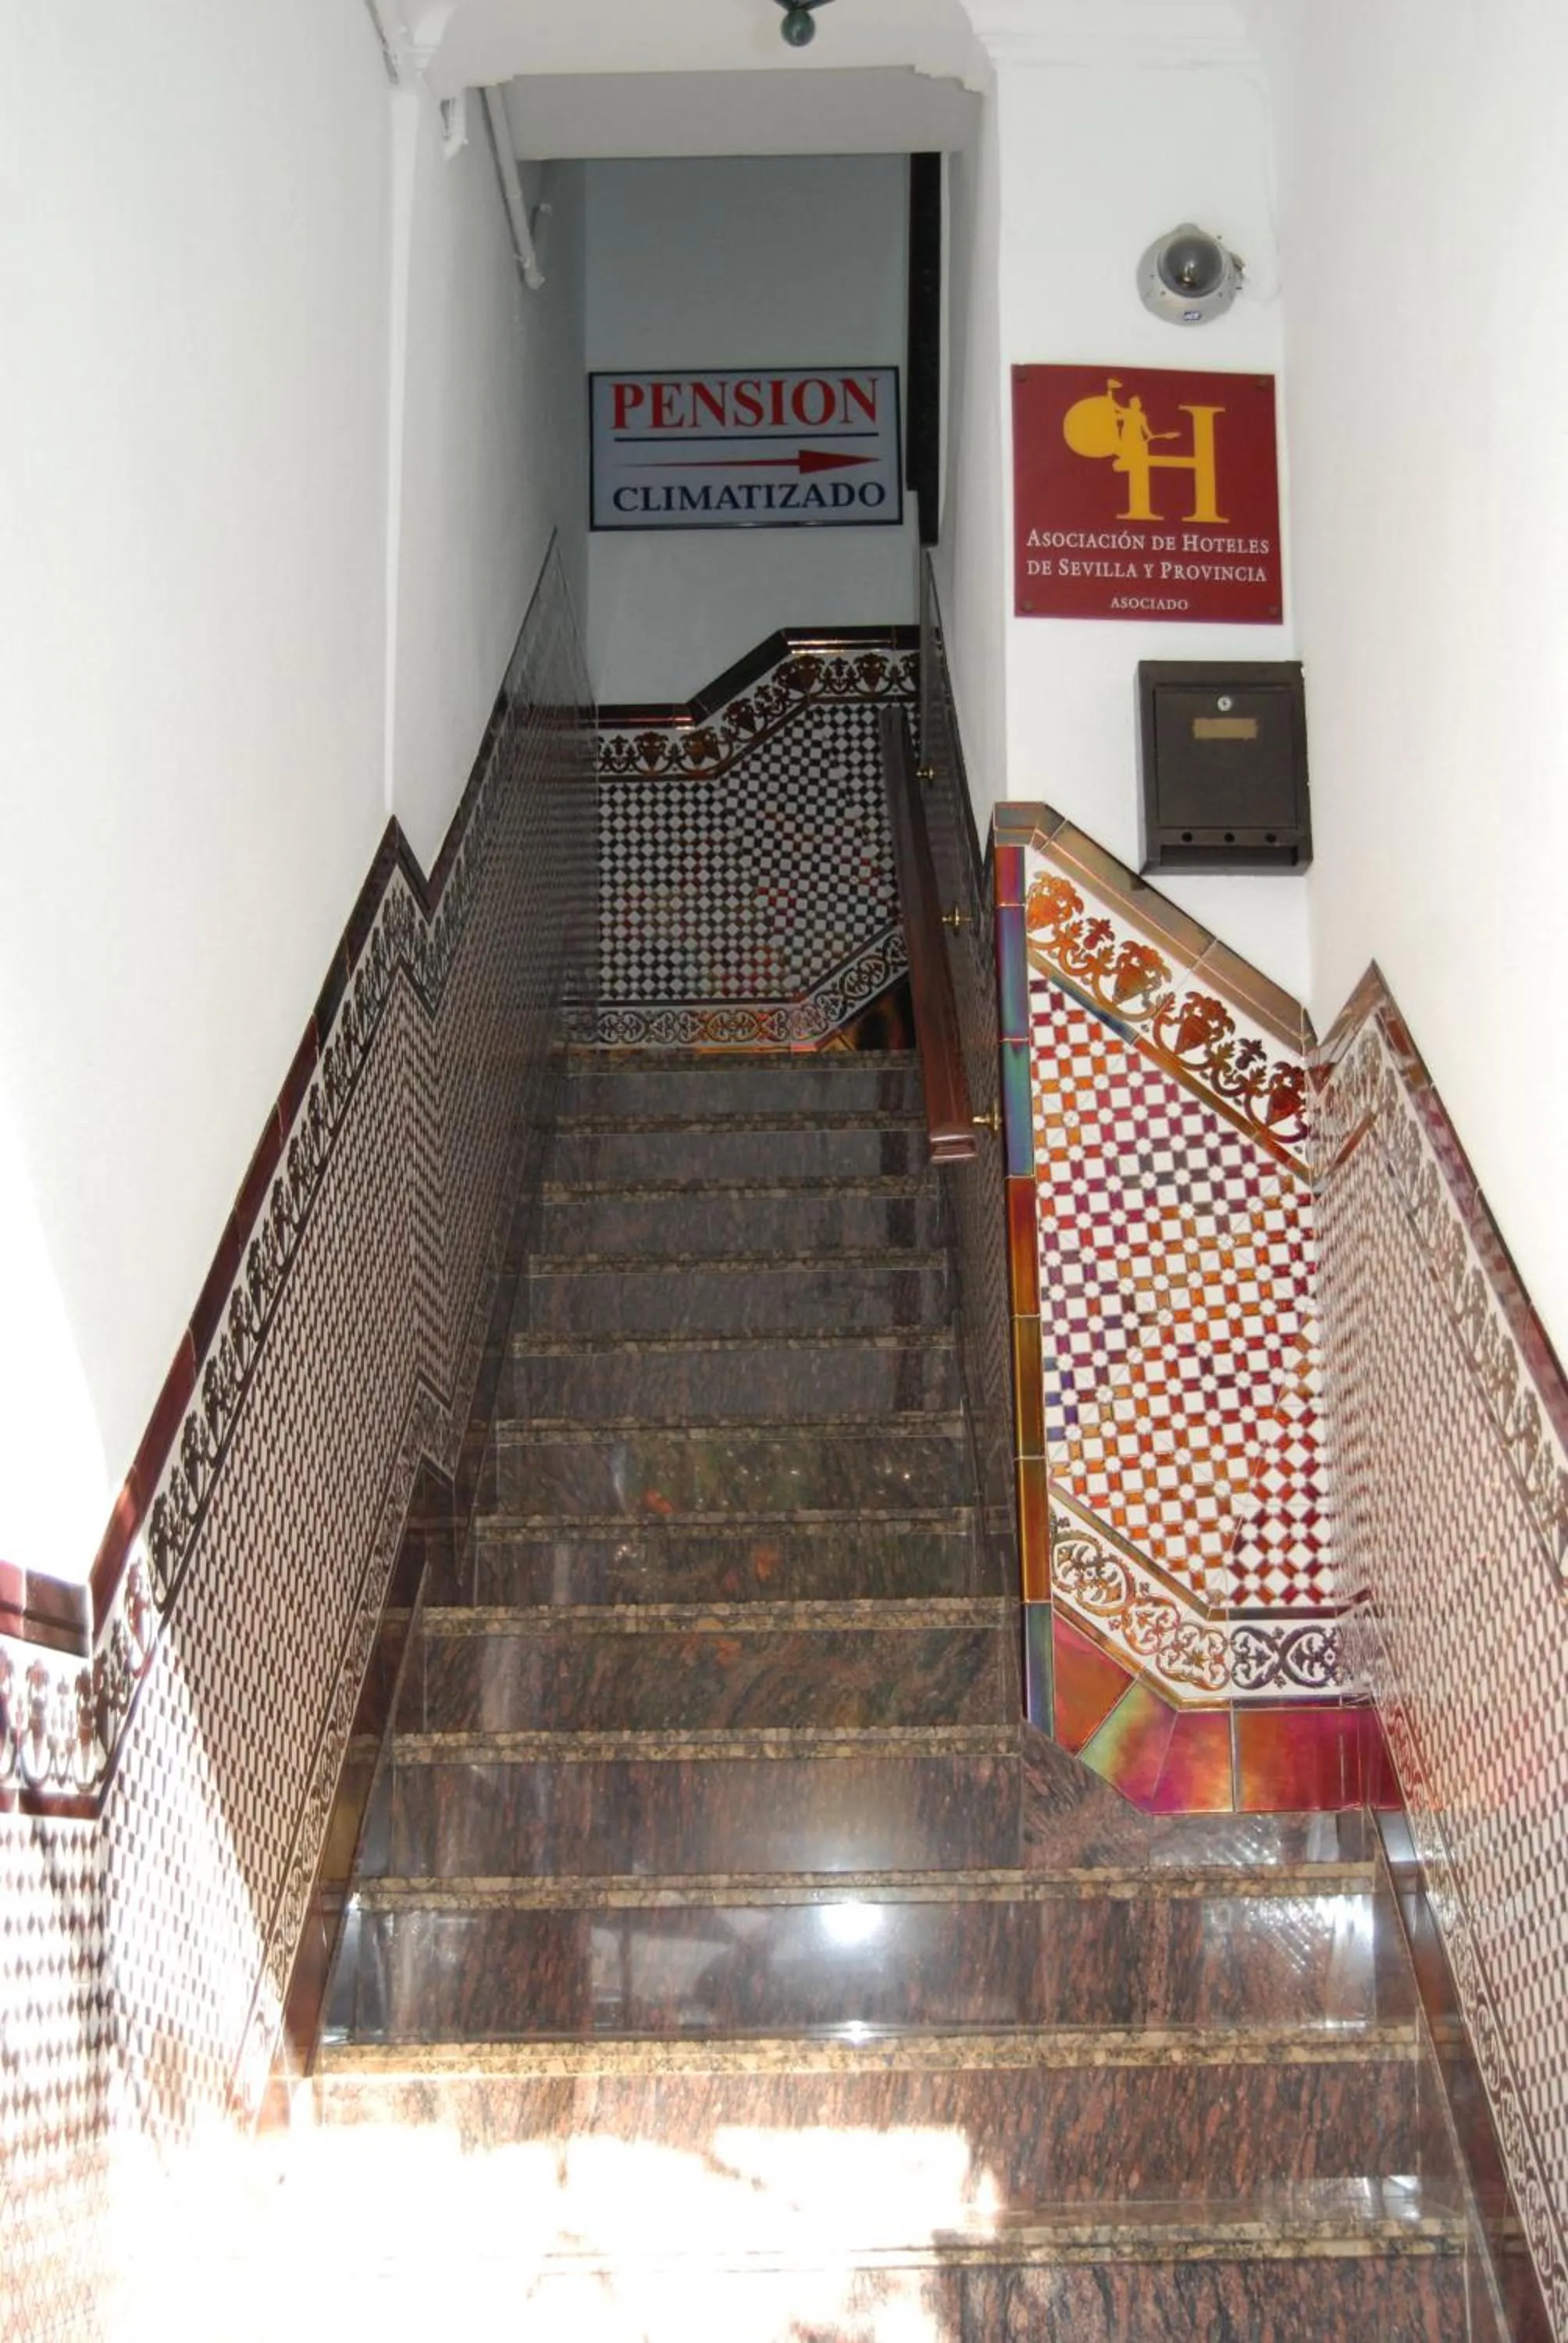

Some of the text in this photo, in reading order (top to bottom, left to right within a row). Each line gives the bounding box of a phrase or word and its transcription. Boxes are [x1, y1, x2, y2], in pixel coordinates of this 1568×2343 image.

[610, 377, 878, 430] PENSION
[612, 481, 886, 512] CLIMATIZADO
[1026, 529, 1270, 555] ASOCIACIÓN DE HOTELES
[1027, 558, 1267, 582] DE SEVILLA Y PROVINCIA
[1110, 597, 1189, 611] ASOCIADO
